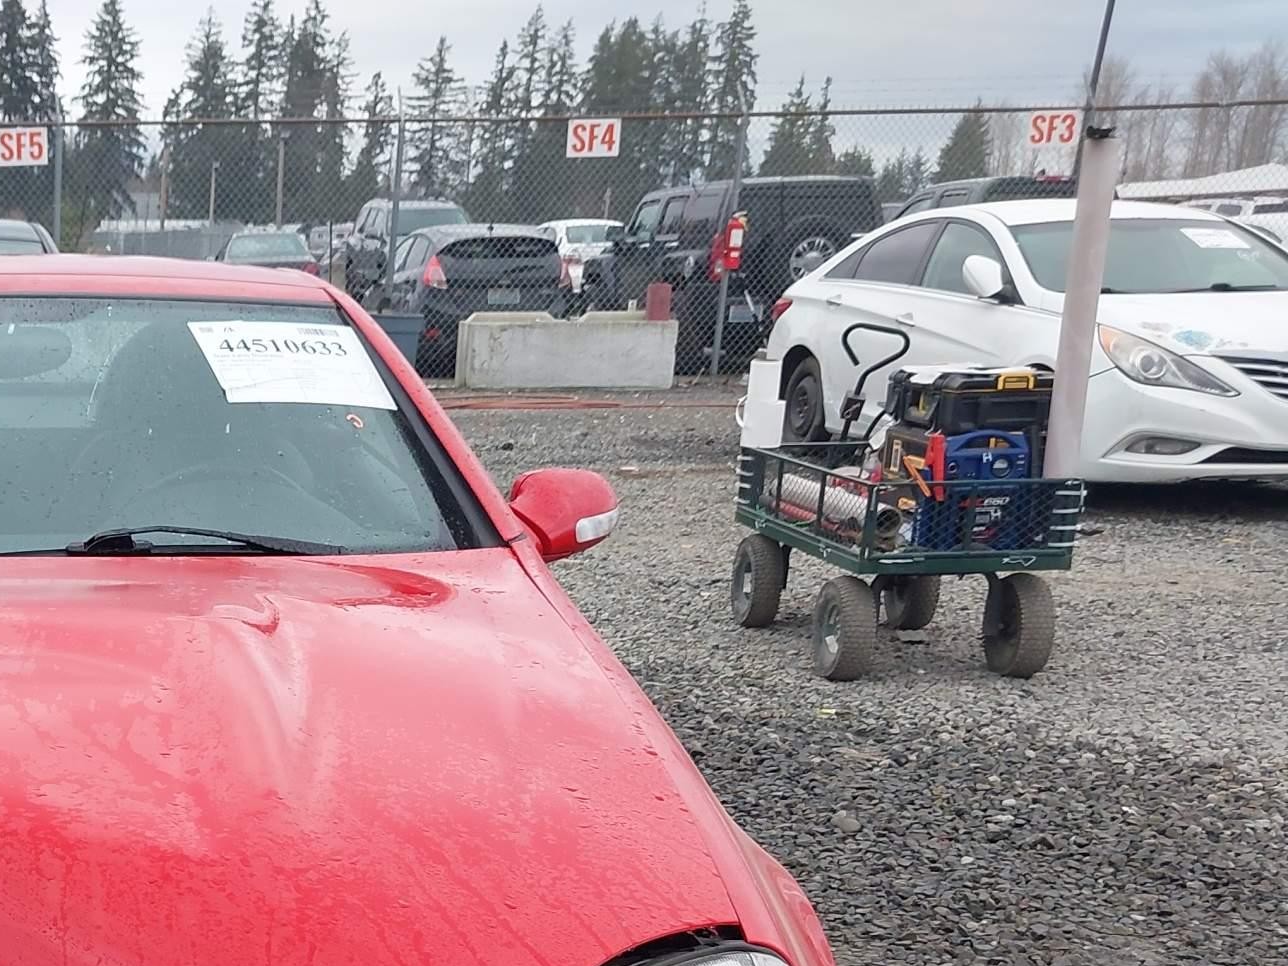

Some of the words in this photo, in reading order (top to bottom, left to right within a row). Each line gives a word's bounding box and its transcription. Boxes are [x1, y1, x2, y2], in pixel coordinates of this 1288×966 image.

[572, 123, 616, 153] SF4
[1030, 114, 1076, 144] SF3
[0, 132, 44, 161] SF5
[219, 338, 348, 357] 44510633
